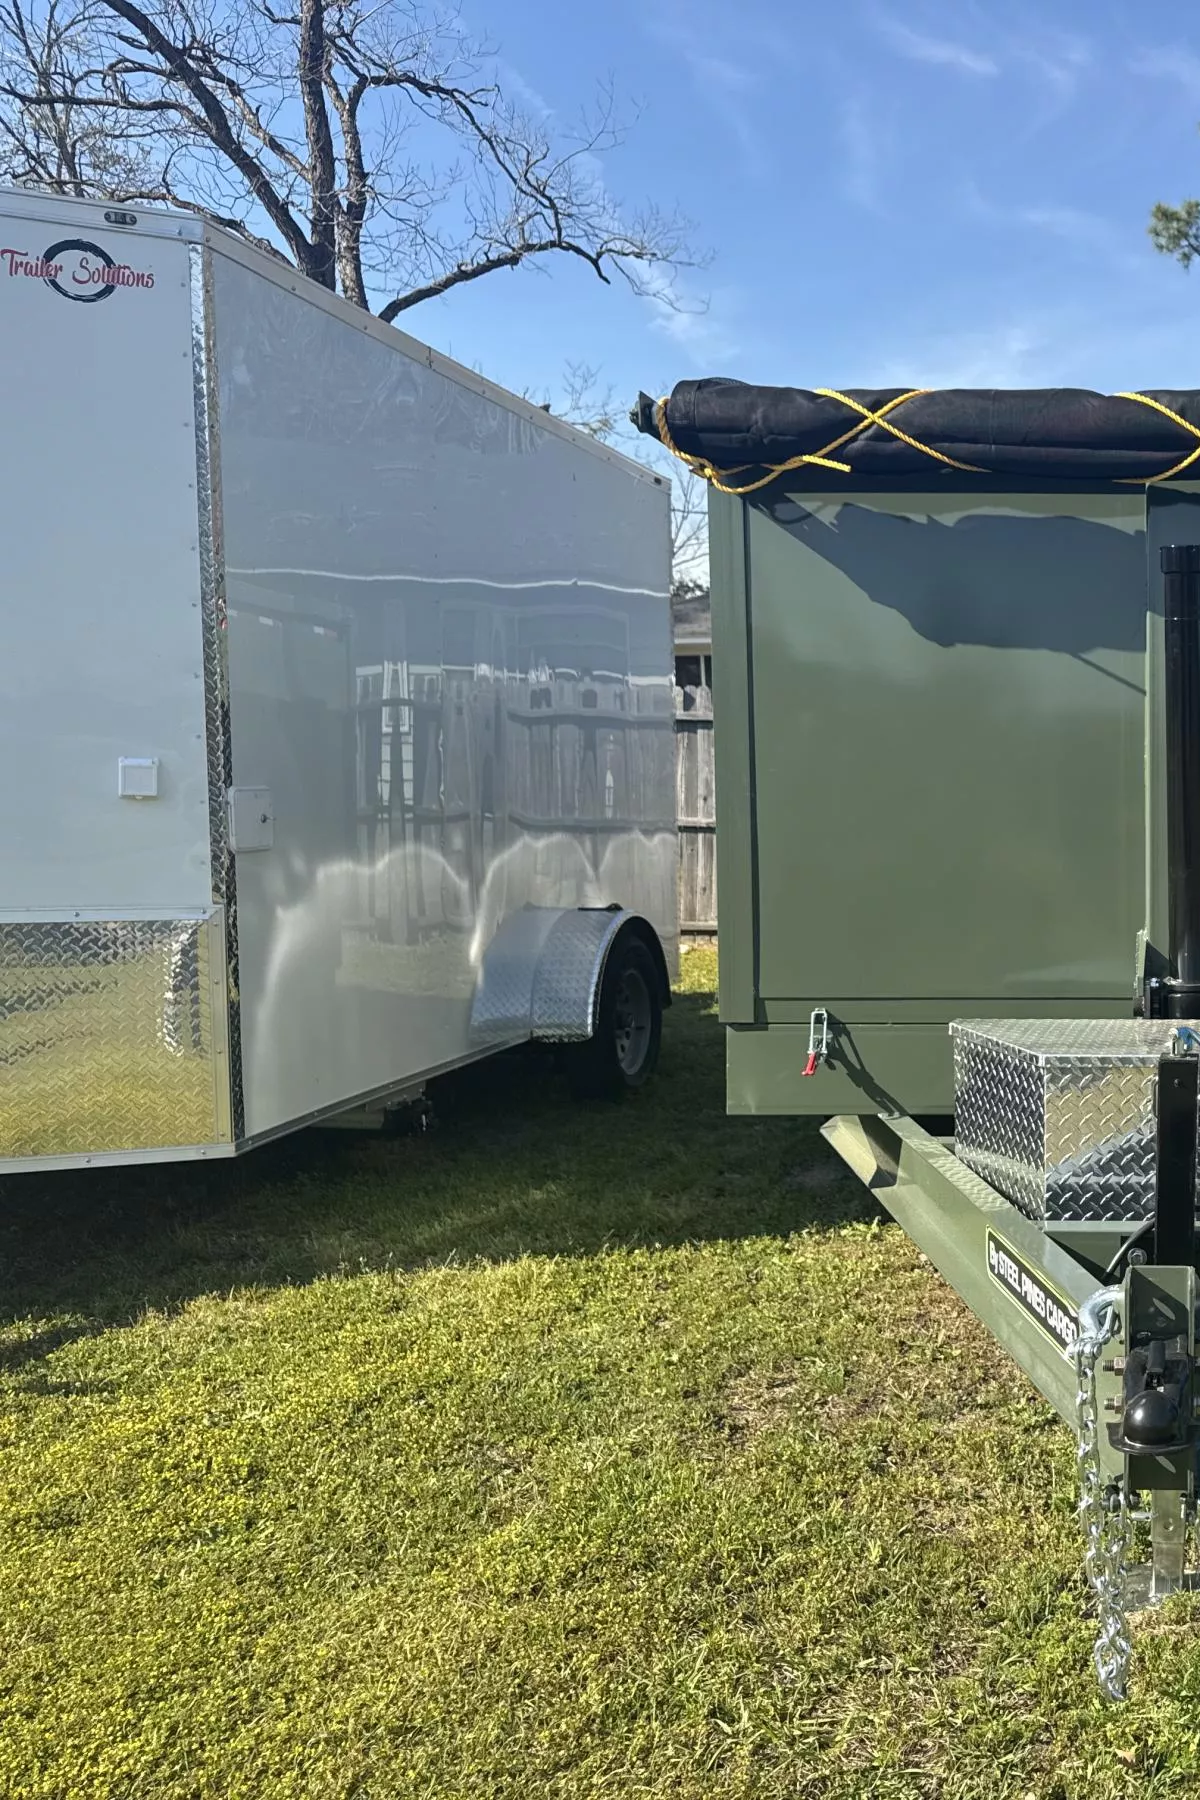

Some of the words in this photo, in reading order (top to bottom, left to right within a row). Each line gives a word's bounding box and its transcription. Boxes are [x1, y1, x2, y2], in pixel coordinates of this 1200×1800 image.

[0, 249, 63, 279] Trailer
[72, 257, 155, 289] Solutions
[989, 1240, 998, 1274] By
[998, 1250, 1021, 1292] STEEL
[1021, 1272, 1046, 1318] PINES
